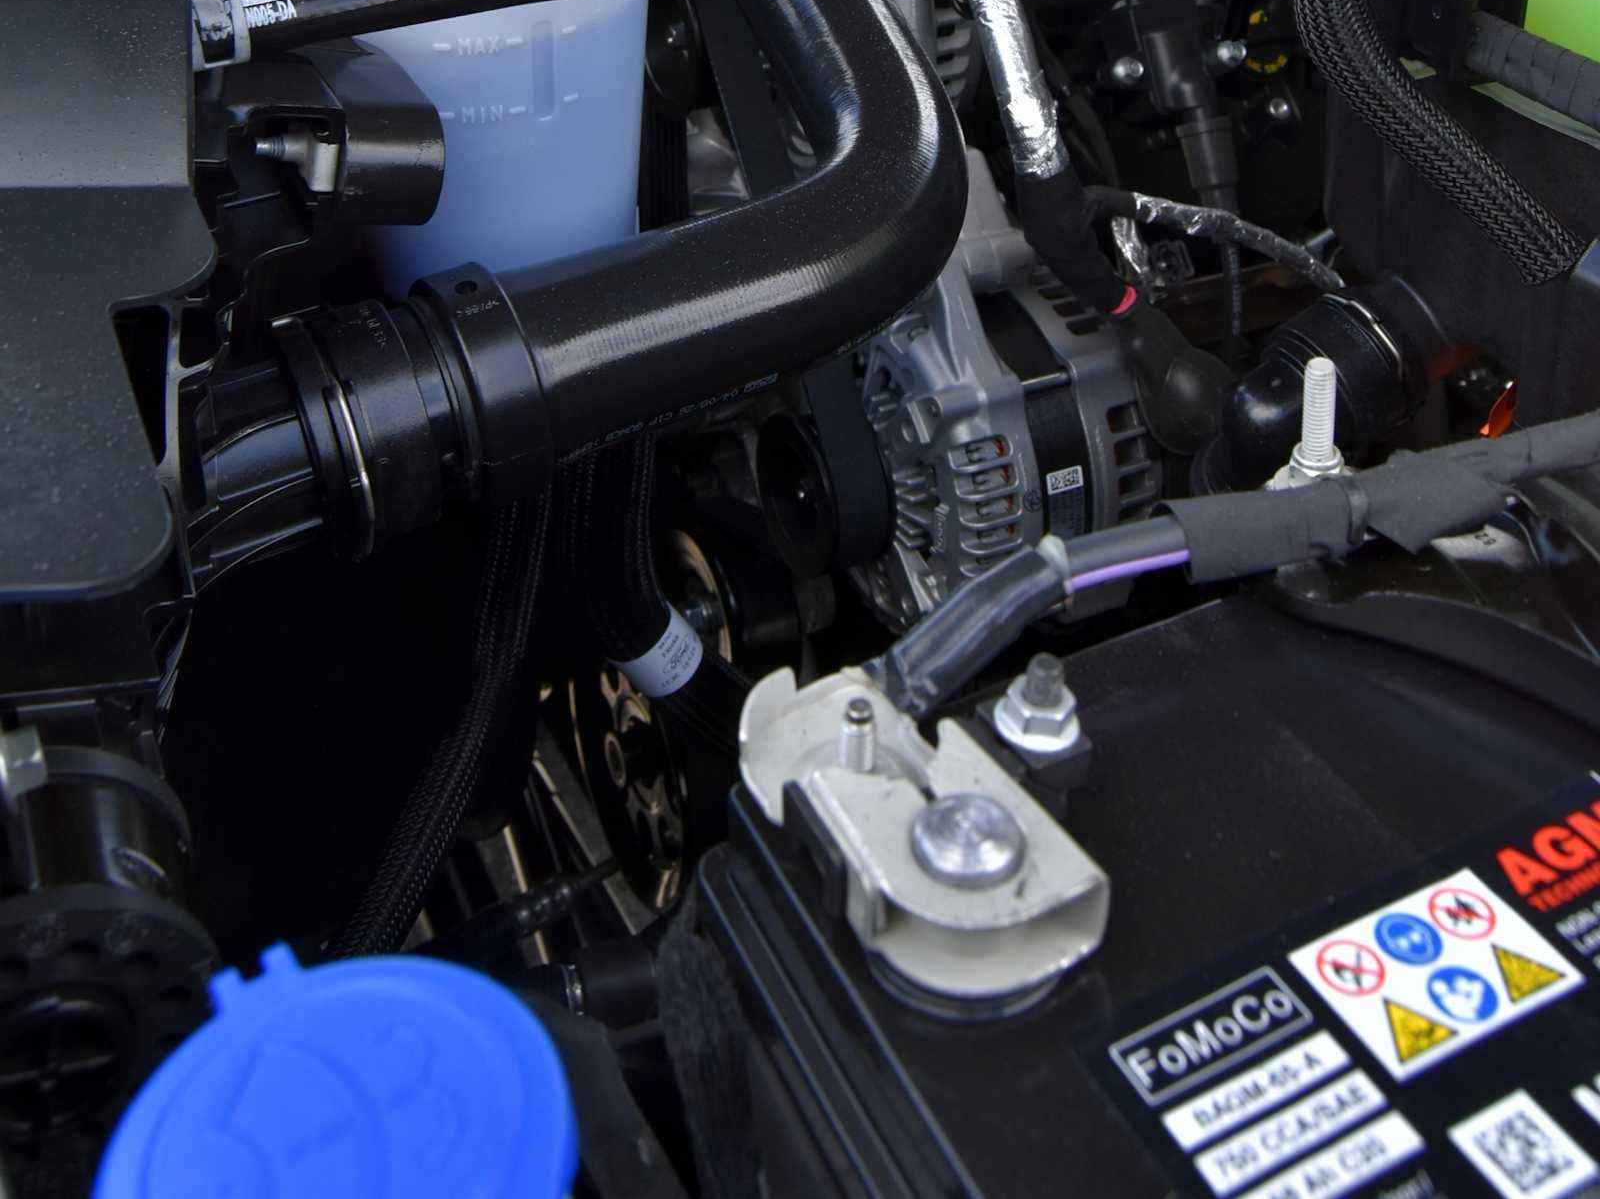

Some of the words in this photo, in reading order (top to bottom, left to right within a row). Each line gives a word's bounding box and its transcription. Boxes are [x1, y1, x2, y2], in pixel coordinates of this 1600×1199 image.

[457, 36, 500, 56] MAX
[461, 104, 504, 124] MIN
[1126, 989, 1294, 1090] FoMoCo
